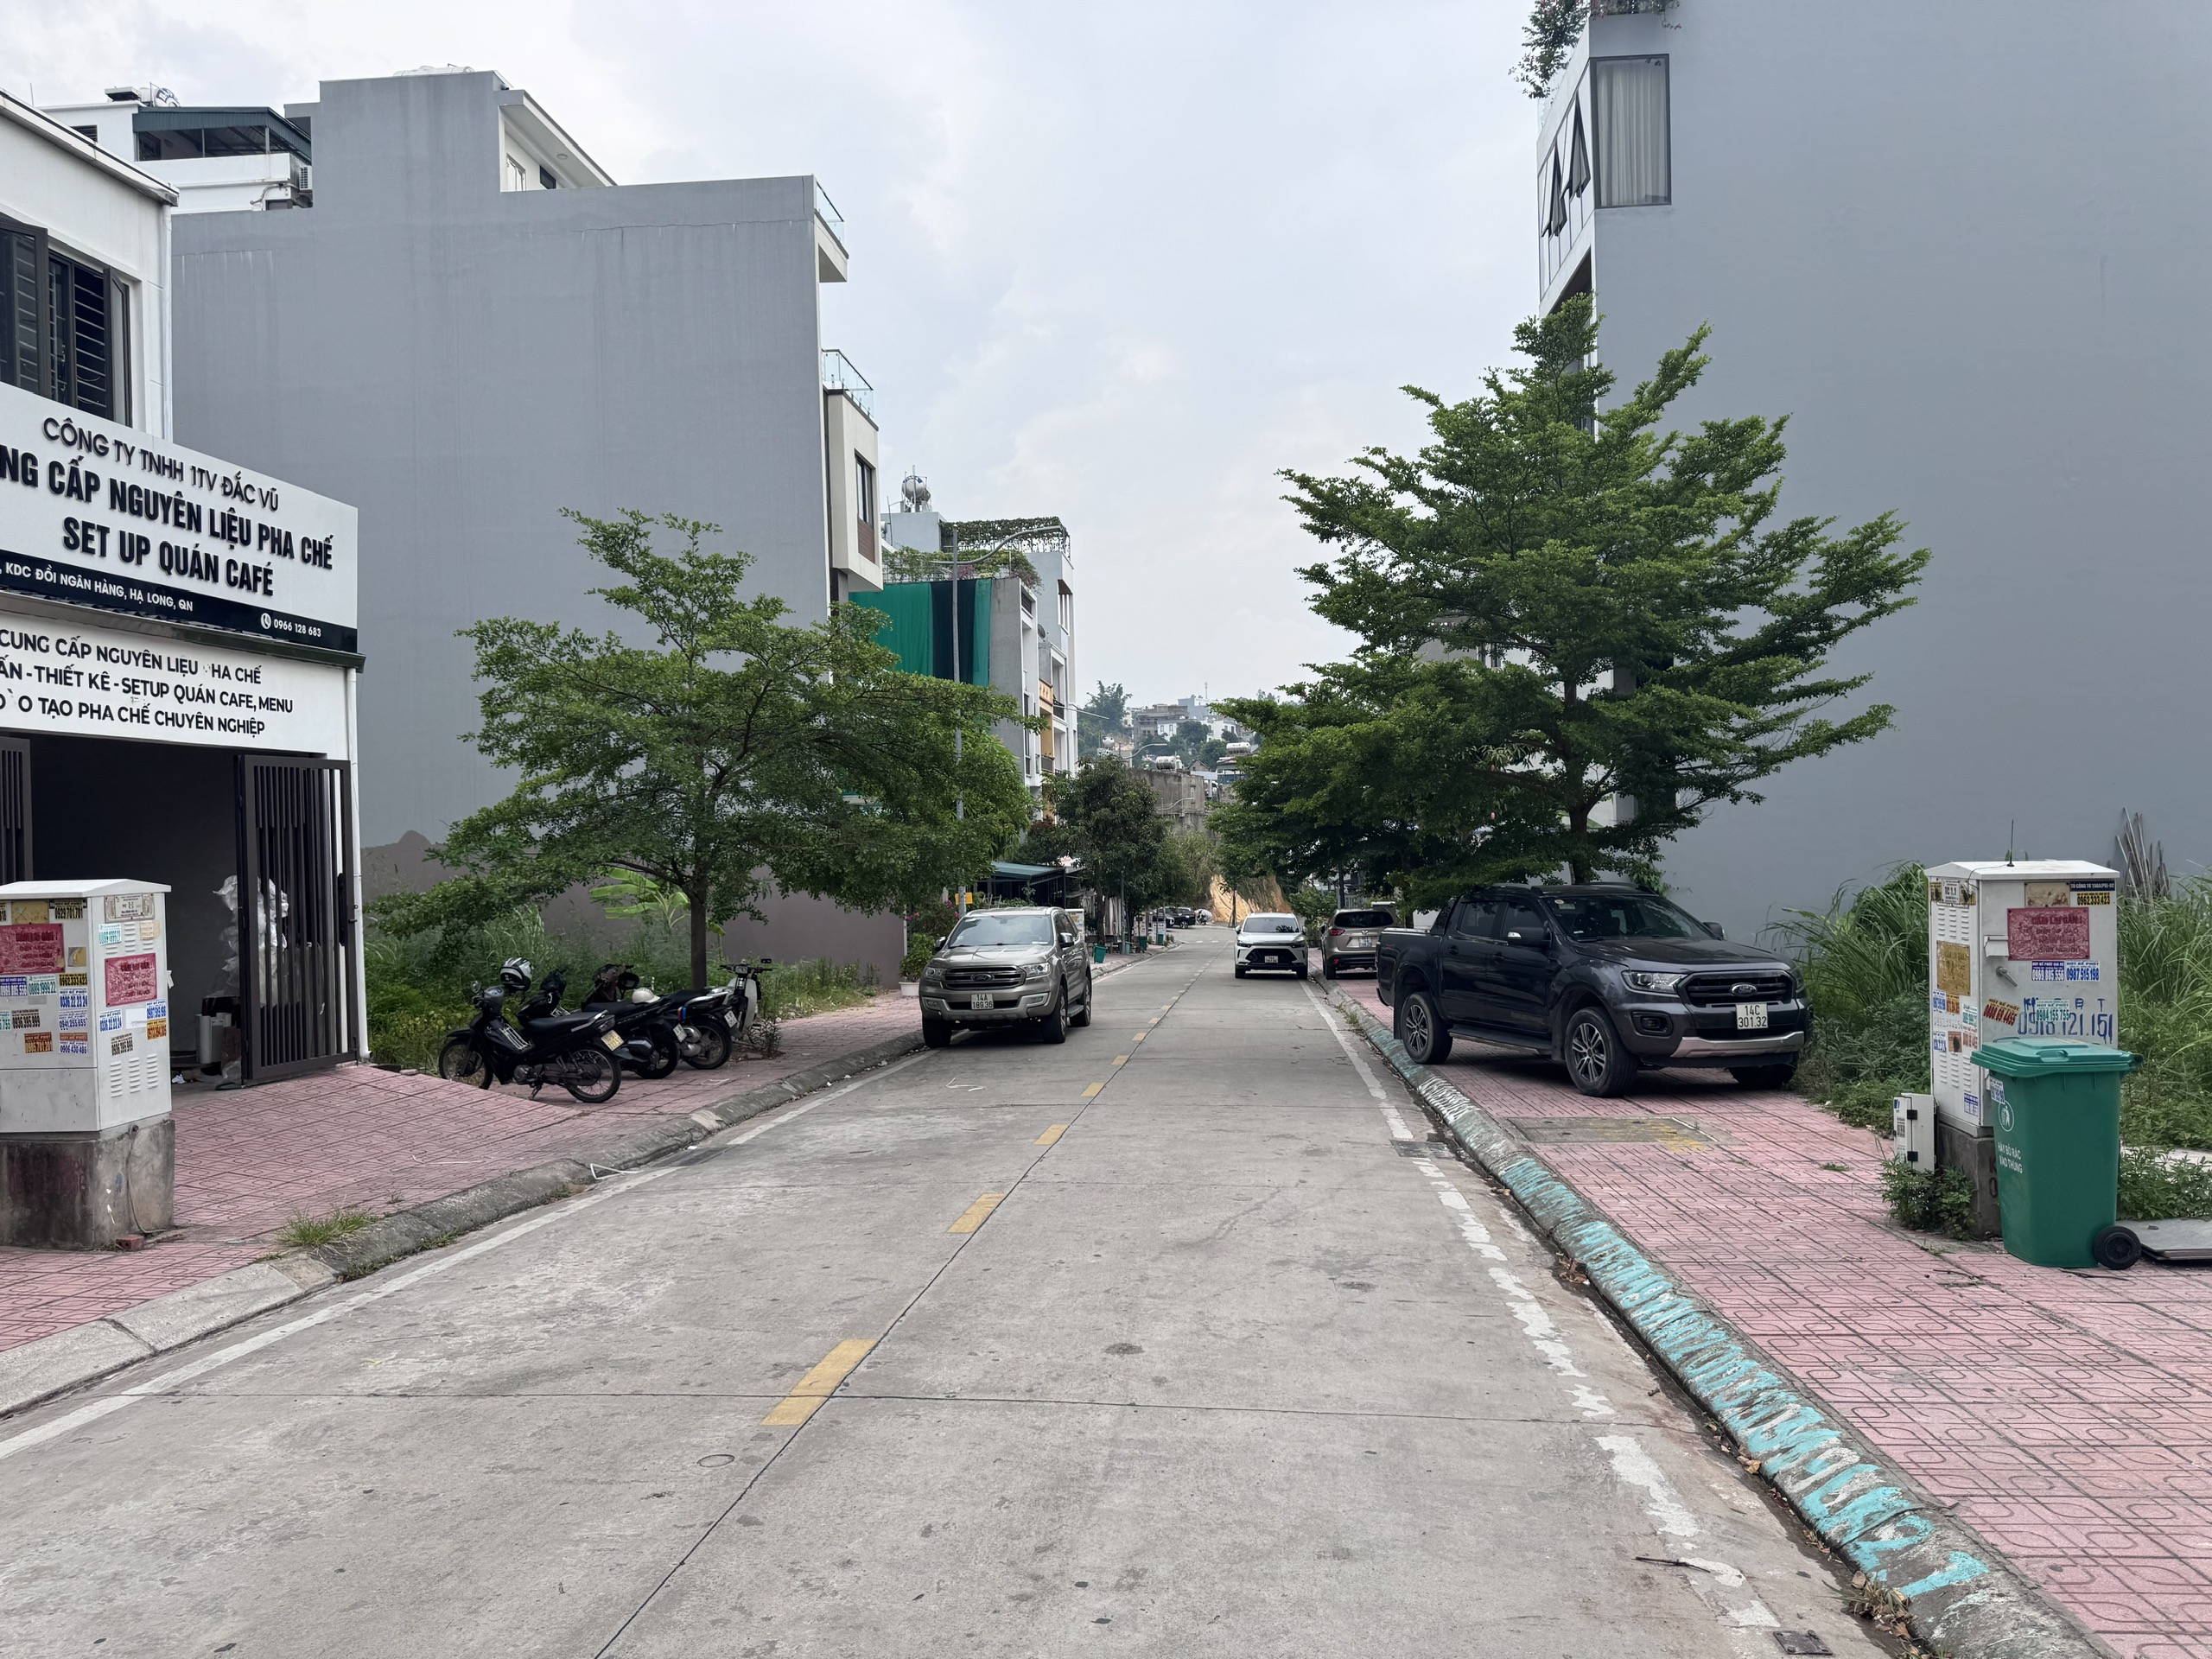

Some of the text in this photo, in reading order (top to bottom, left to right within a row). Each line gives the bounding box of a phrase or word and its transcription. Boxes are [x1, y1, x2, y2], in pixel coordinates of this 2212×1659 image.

[43, 416, 279, 511] CÔNG TY TNHH 1TV ĐẮC VŨ
[48, 455, 101, 503] CẤP
[108, 477, 202, 533] NGUYÊN
[209, 507, 251, 550] LIỆU
[257, 523, 295, 559] PHA
[301, 534, 334, 569] CHẾ
[62, 516, 273, 596] SET UP QUÁN CAFÉ
[6, 562, 193, 612] KDC ĐỒI NGÂN HÀNG, HẠ LONG, QN
[273, 619, 321, 637] 0966 128 683
[0, 629, 50, 653] CUNG
[55, 636, 92, 659] CẤP
[96, 645, 162, 670] NGUYÊN
[235, 665, 262, 684] CHẾ
[38, 696, 73, 719] TẠO
[78, 702, 114, 721] PHA
[118, 703, 150, 725] CHẾ
[154, 710, 214, 731] CHUYÊN
[218, 717, 265, 738] NGHIỆP
[174, 683, 216, 704] QUÁN
[258, 696, 293, 713] MENU
[1738, 1016, 1767, 1028] 301.32
[1744, 1005, 1760, 1016] 14C
